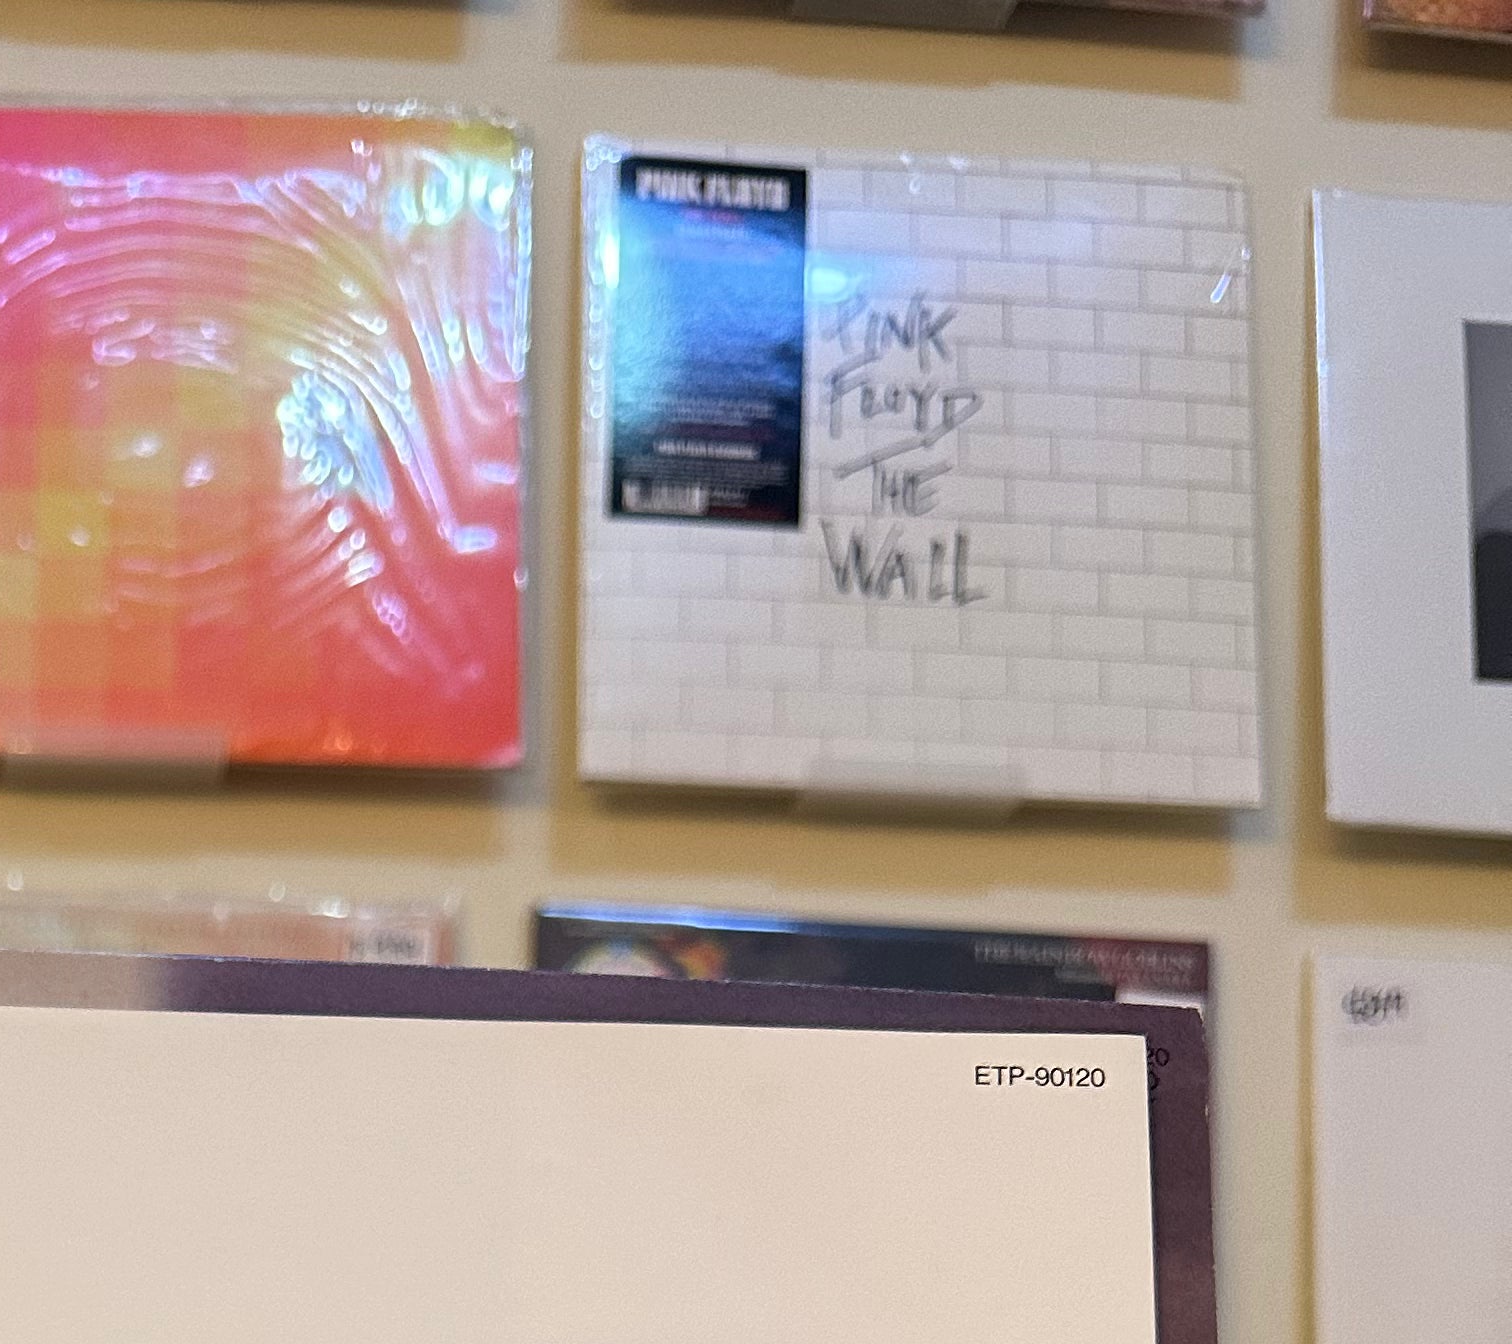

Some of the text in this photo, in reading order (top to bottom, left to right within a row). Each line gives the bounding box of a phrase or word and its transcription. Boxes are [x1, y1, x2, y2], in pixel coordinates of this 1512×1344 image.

[822, 291, 958, 372] PINK
[819, 516, 990, 606] WALL
[975, 1065, 1106, 1088] ETP-90120
